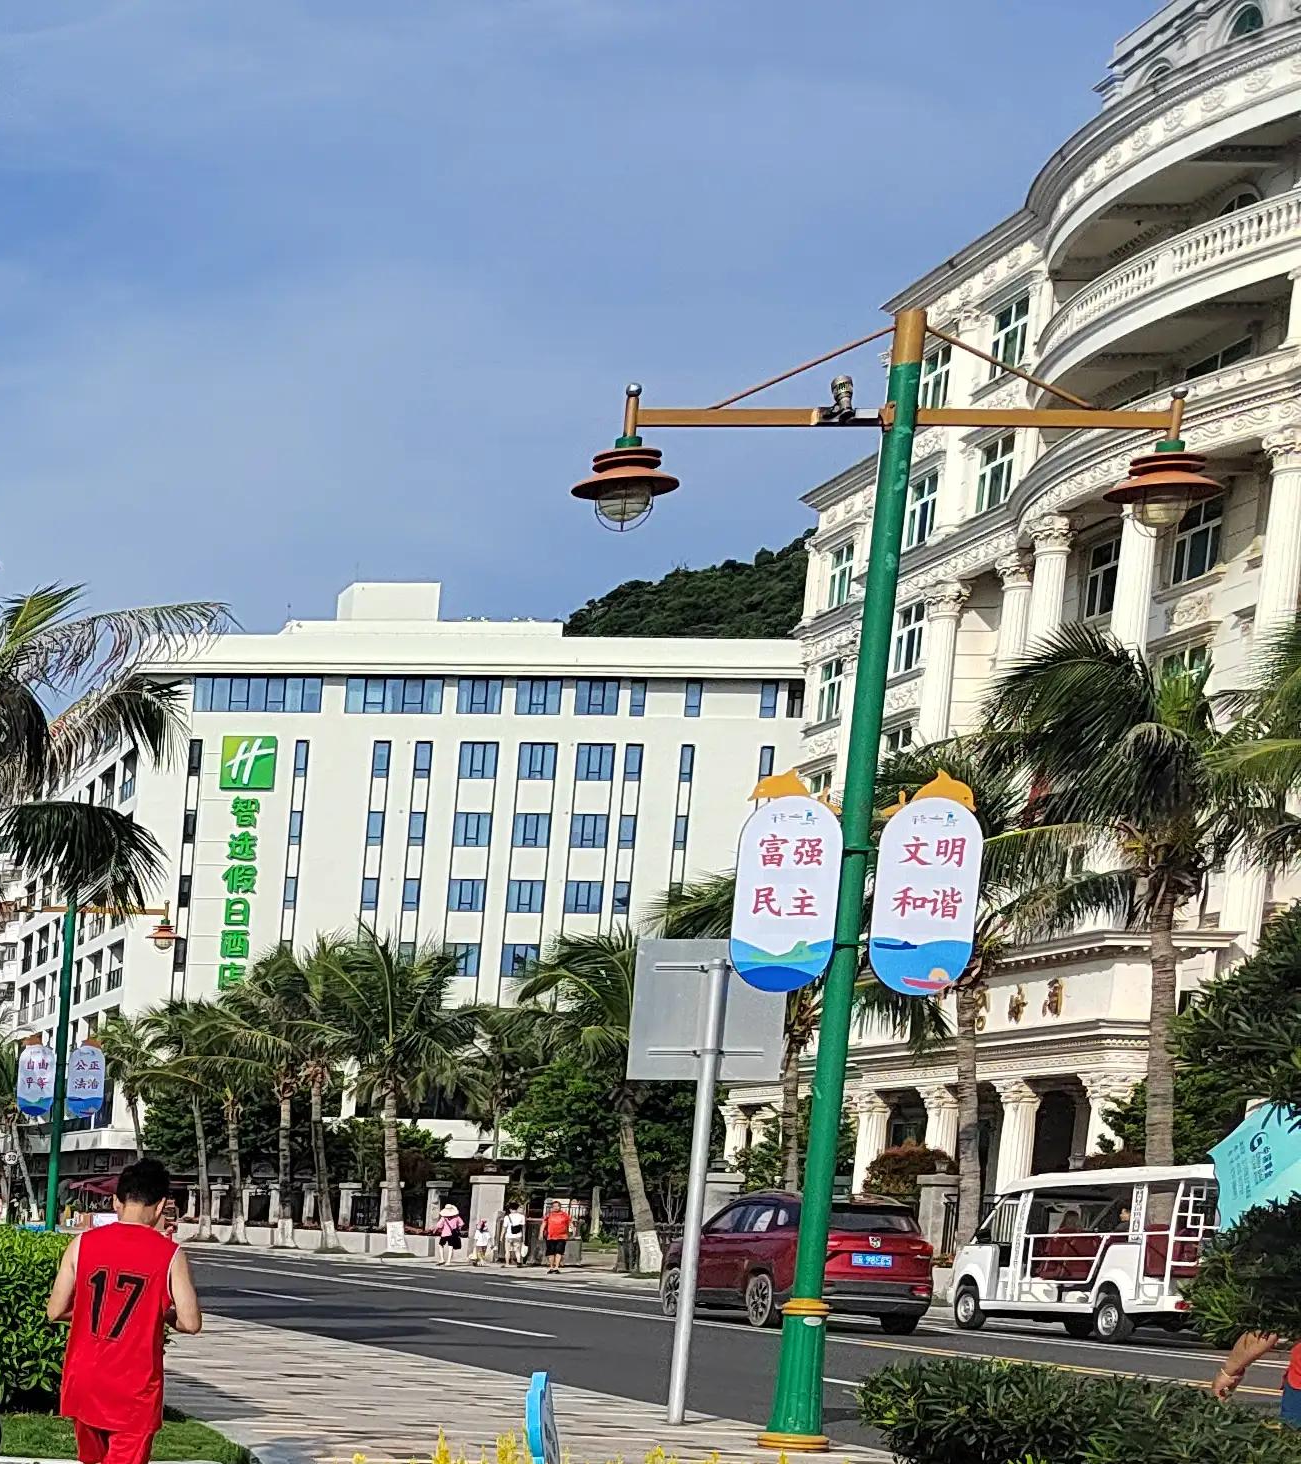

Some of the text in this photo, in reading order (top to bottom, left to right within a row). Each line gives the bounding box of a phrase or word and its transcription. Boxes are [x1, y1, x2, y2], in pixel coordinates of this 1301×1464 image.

[759, 834, 824, 867] 富强
[899, 836, 967, 868] 文明
[218, 797, 260, 990] 智选假日酒店
[752, 887, 819, 918] 民主
[892, 886, 963, 920] 和谐
[75, 1059, 100, 1071] 公正
[74, 1078, 99, 1089] 法治
[87, 1266, 150, 1341] 17
